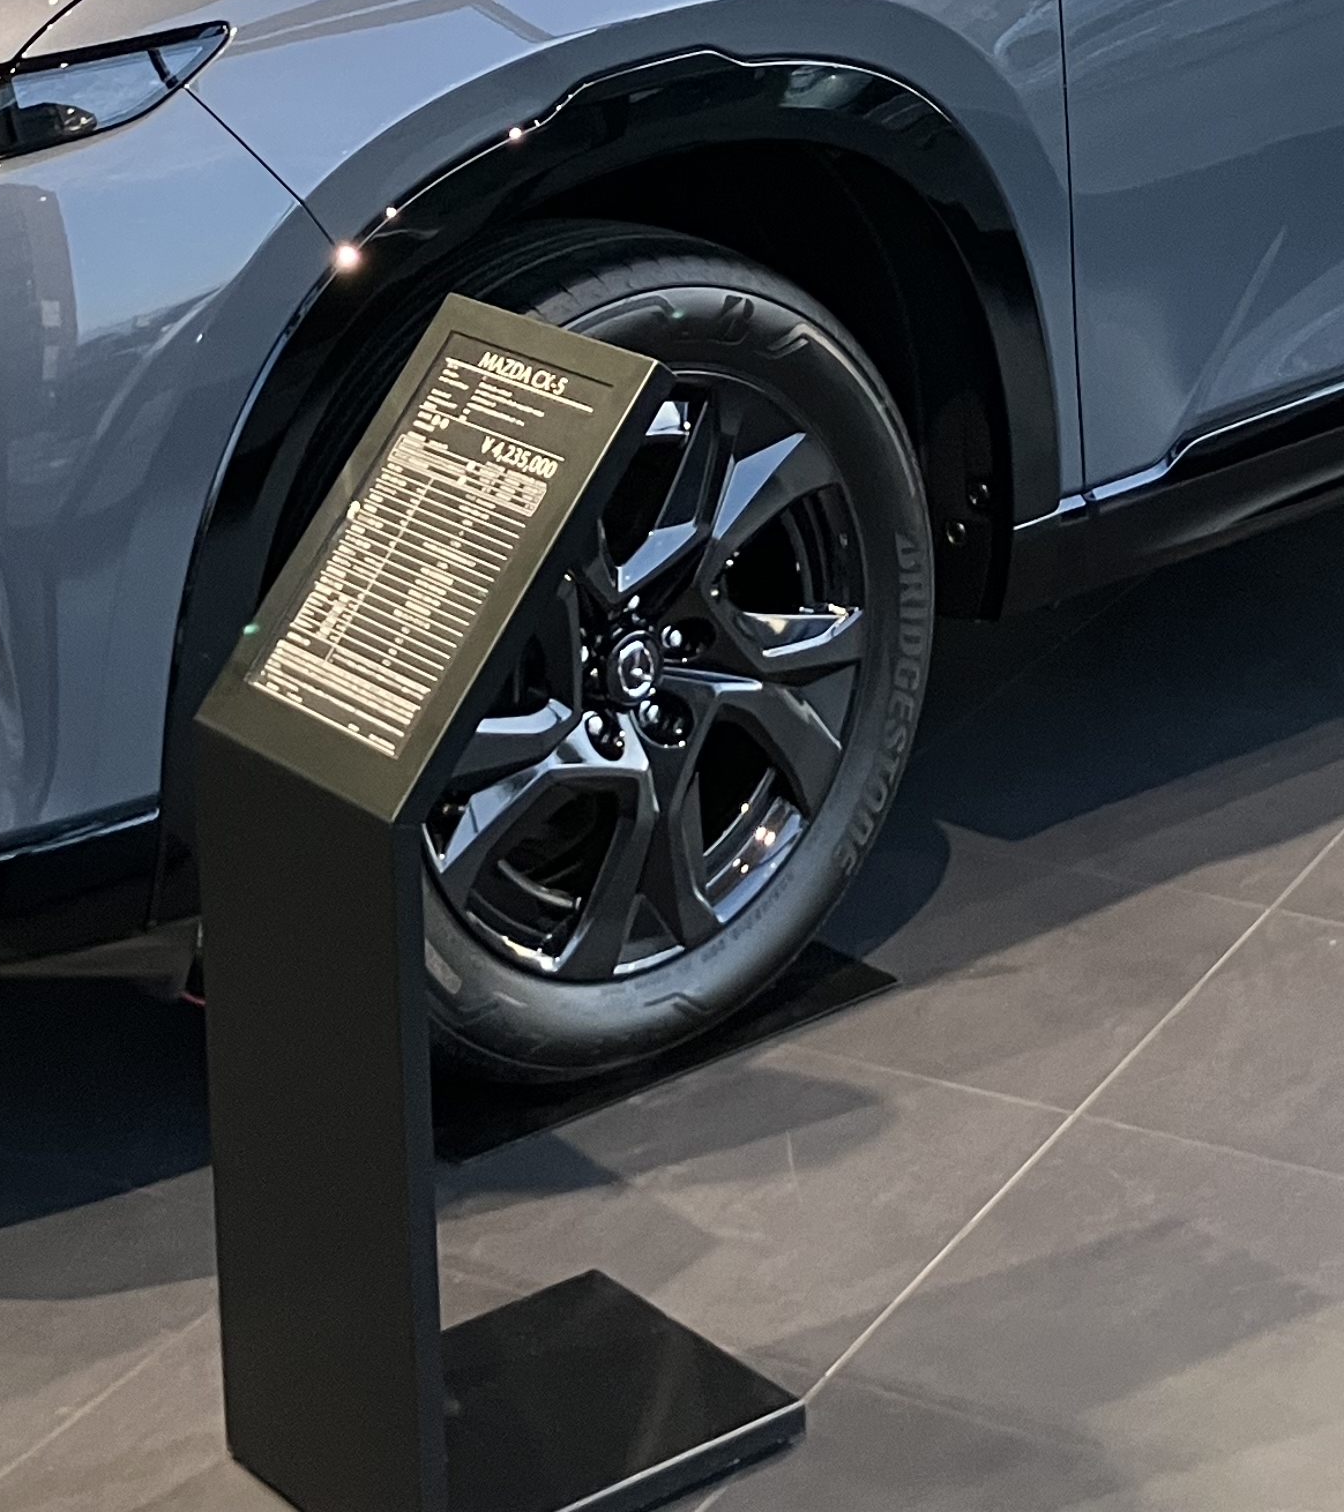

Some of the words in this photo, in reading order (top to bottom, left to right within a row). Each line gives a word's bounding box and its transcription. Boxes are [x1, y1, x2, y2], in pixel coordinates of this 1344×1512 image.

[477, 351, 532, 384] MAZDA
[531, 369, 569, 396] CX-5
[834, 531, 931, 876] BRIDGESTONE
